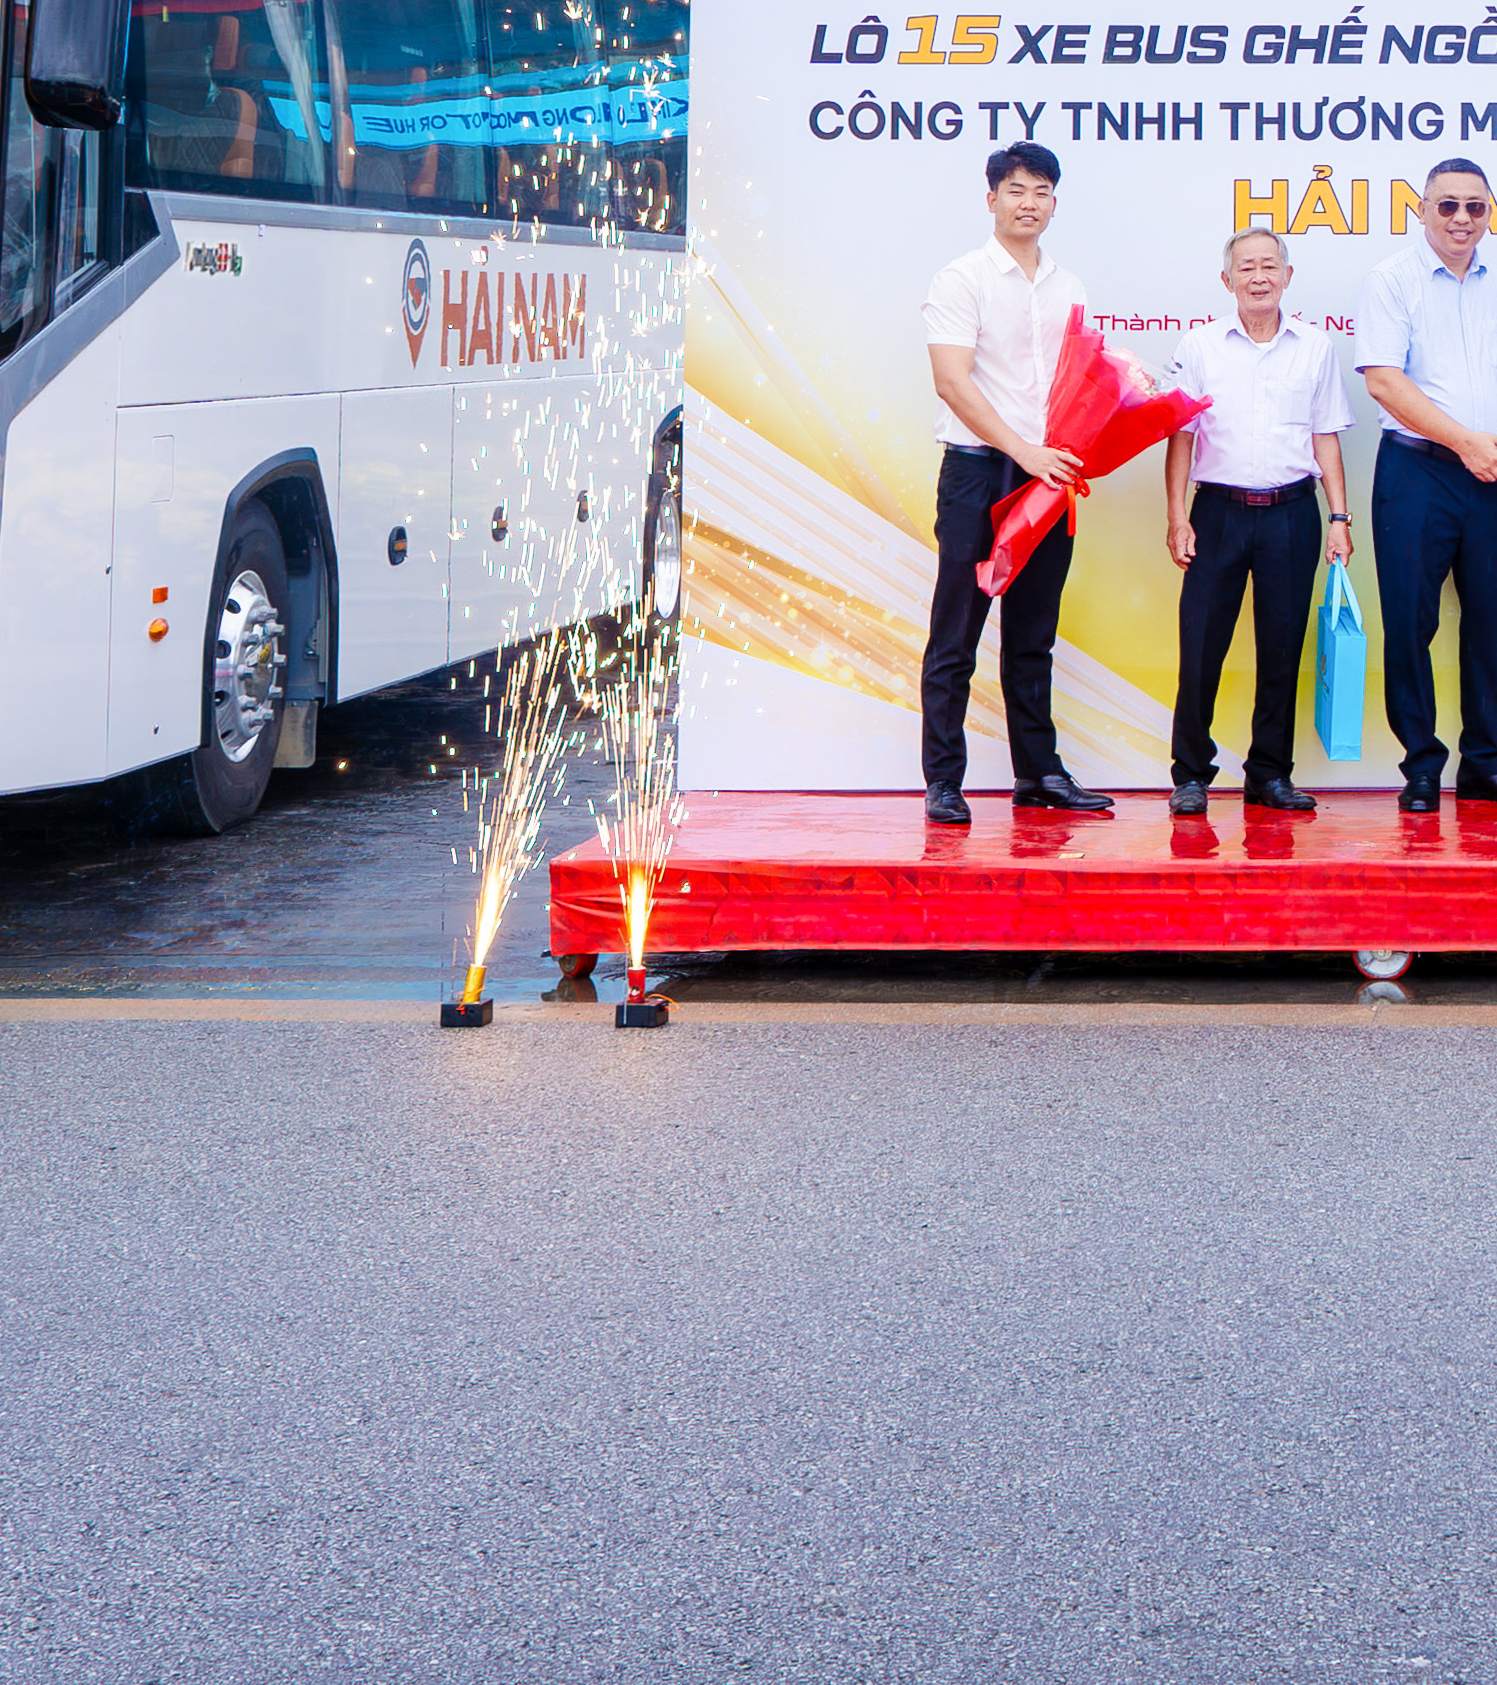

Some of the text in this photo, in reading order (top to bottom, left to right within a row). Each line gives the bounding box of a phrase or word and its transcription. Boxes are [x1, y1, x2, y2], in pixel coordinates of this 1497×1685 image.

[809, 16, 890, 64] LÔ
[897, 14, 1002, 65] 15
[1007, 24, 1091, 64] XE
[1102, 24, 1227, 64] BUS
[1242, 5, 1367, 64] GHẾ
[808, 90, 964, 142] CÔNG
[978, 101, 1047, 141] TY
[1062, 101, 1203, 141] TNHH
[1219, 95, 1445, 142] THƯƠNG
[1233, 165, 1369, 235] HẢI
[511, 272, 587, 364] NAM
[1093, 313, 1181, 331] Thành
